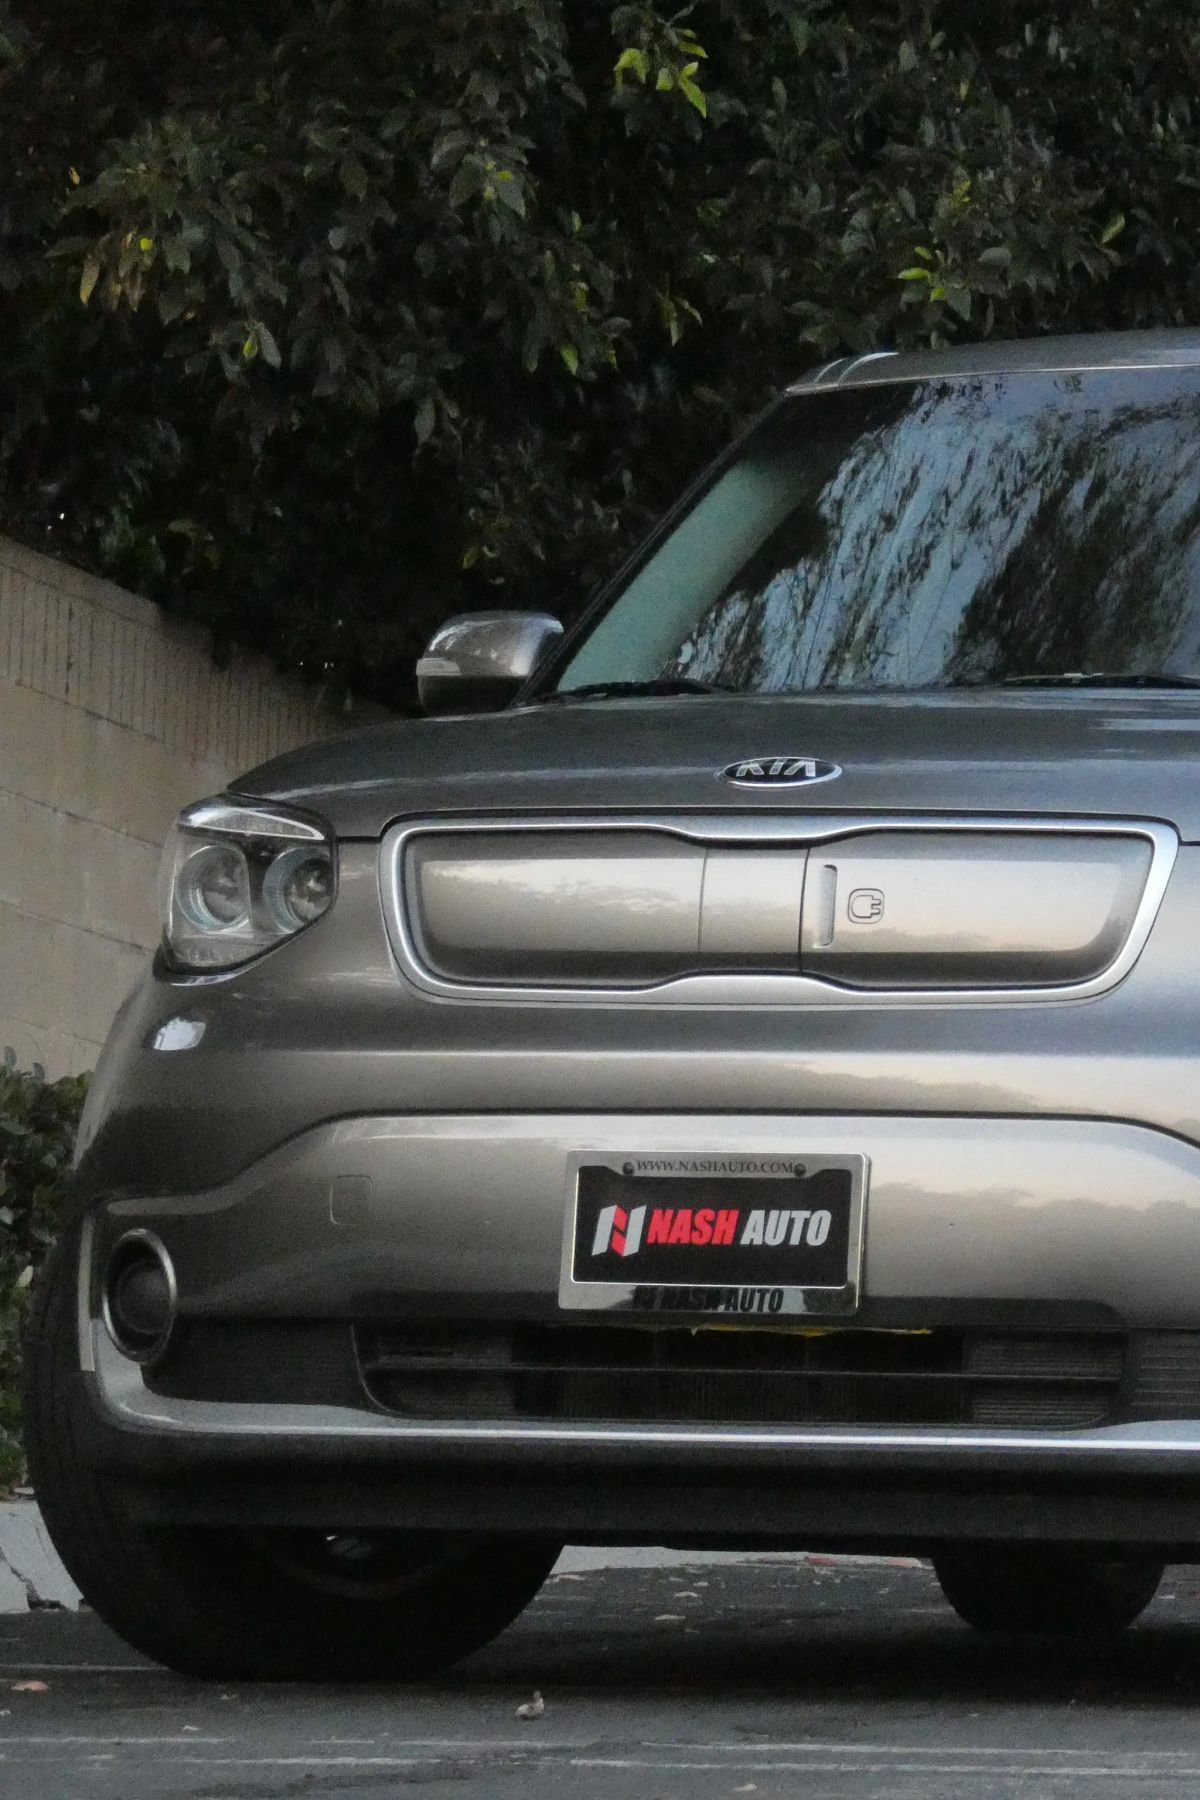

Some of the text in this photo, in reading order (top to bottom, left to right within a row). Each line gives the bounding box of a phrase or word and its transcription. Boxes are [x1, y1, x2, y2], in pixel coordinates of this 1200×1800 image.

[735, 758, 817, 777] KIA
[637, 1160, 793, 1174] WWW.NASHAUTO.COM
[646, 1208, 739, 1245] NASH
[740, 1209, 832, 1247] AUTO
[724, 1287, 784, 1312] AUTO
